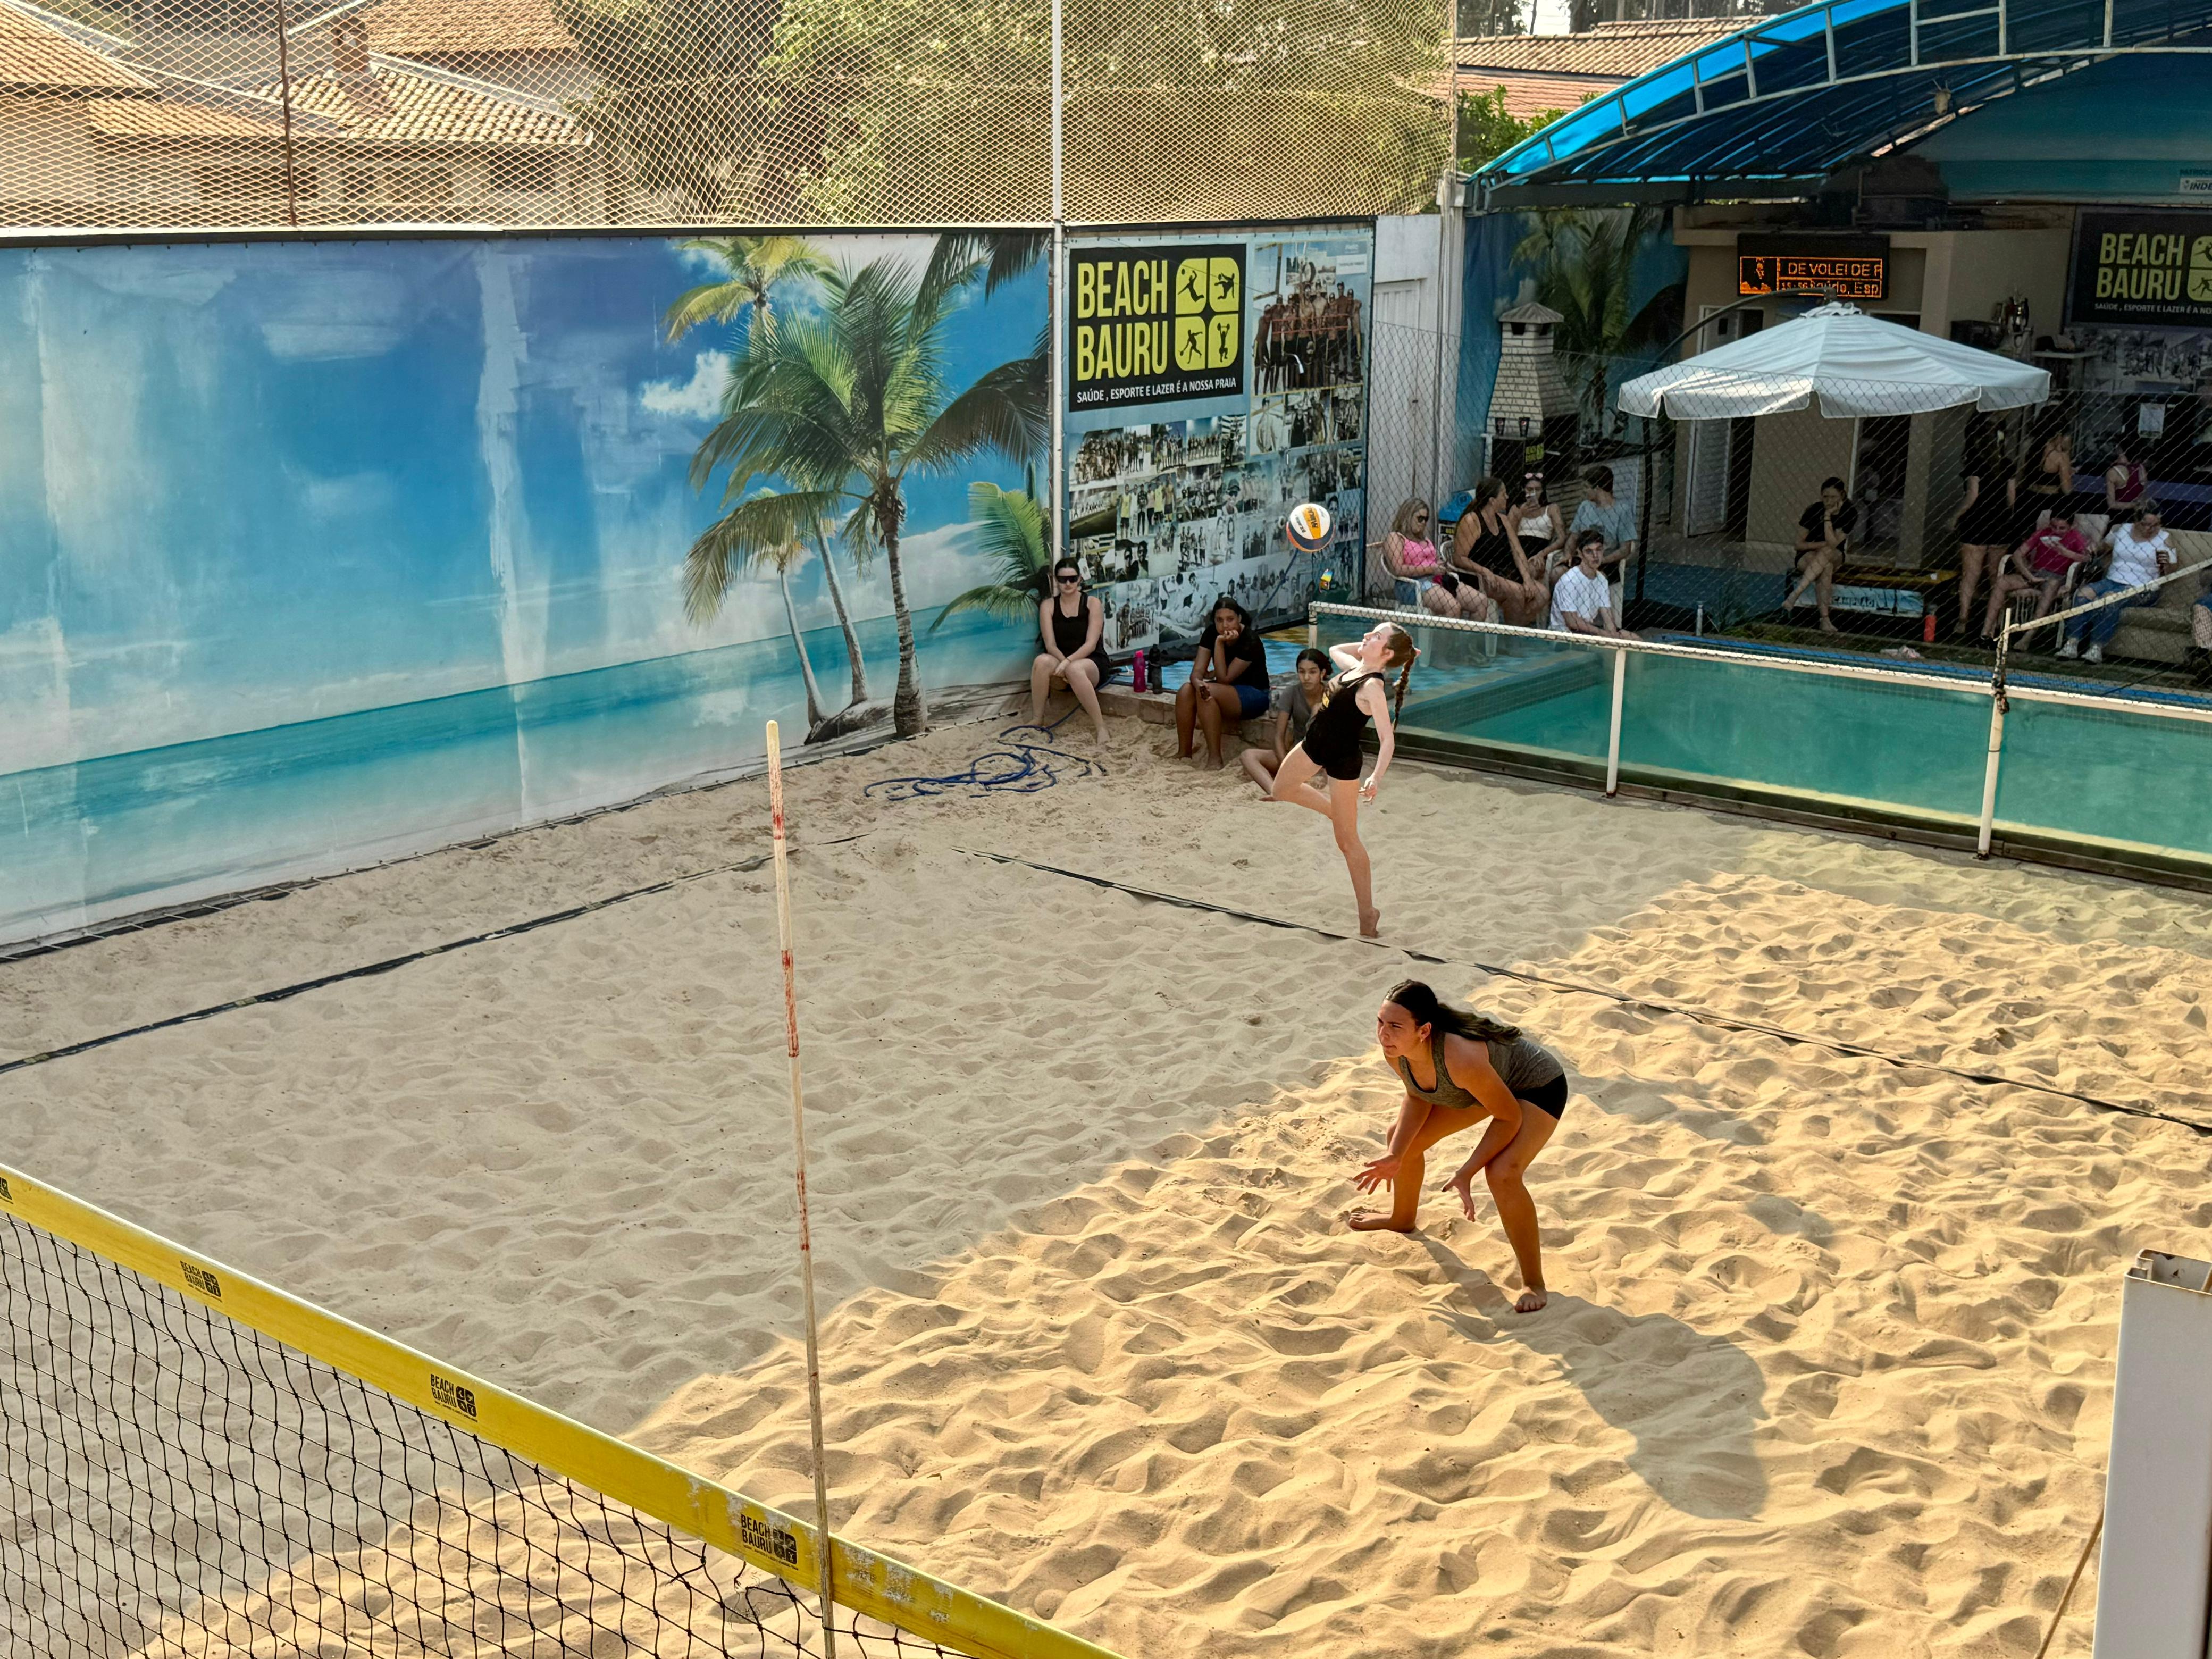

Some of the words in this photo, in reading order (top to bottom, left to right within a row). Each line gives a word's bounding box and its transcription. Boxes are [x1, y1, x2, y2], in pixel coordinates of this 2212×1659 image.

[2099, 233, 2185, 266] BEACH
[1788, 262, 1806, 275] DE
[1809, 263, 1847, 276] VOLEI
[1851, 264, 1871, 276] DE
[1077, 259, 1168, 319] BEACH
[2096, 267, 2182, 301] BAURU
[2186, 305, 2191, 313] É
[1077, 321, 1168, 381] BAURU
[1111, 386, 1144, 400] ESPORTE
[1146, 386, 1151, 396] E
[1152, 383, 1175, 396] LAZER
[1177, 382, 1180, 393] É
[1182, 383, 1188, 392] A
[1189, 380, 1214, 392] NOSSA
[1215, 377, 1236, 389] PRAIA
[180, 1260, 203, 1279] BEACH
[431, 1373, 454, 1396] BEACH
[431, 1387, 457, 1408] BAURU
[741, 1514, 770, 1539] BEACH
[742, 1529, 772, 1554] BAURU
